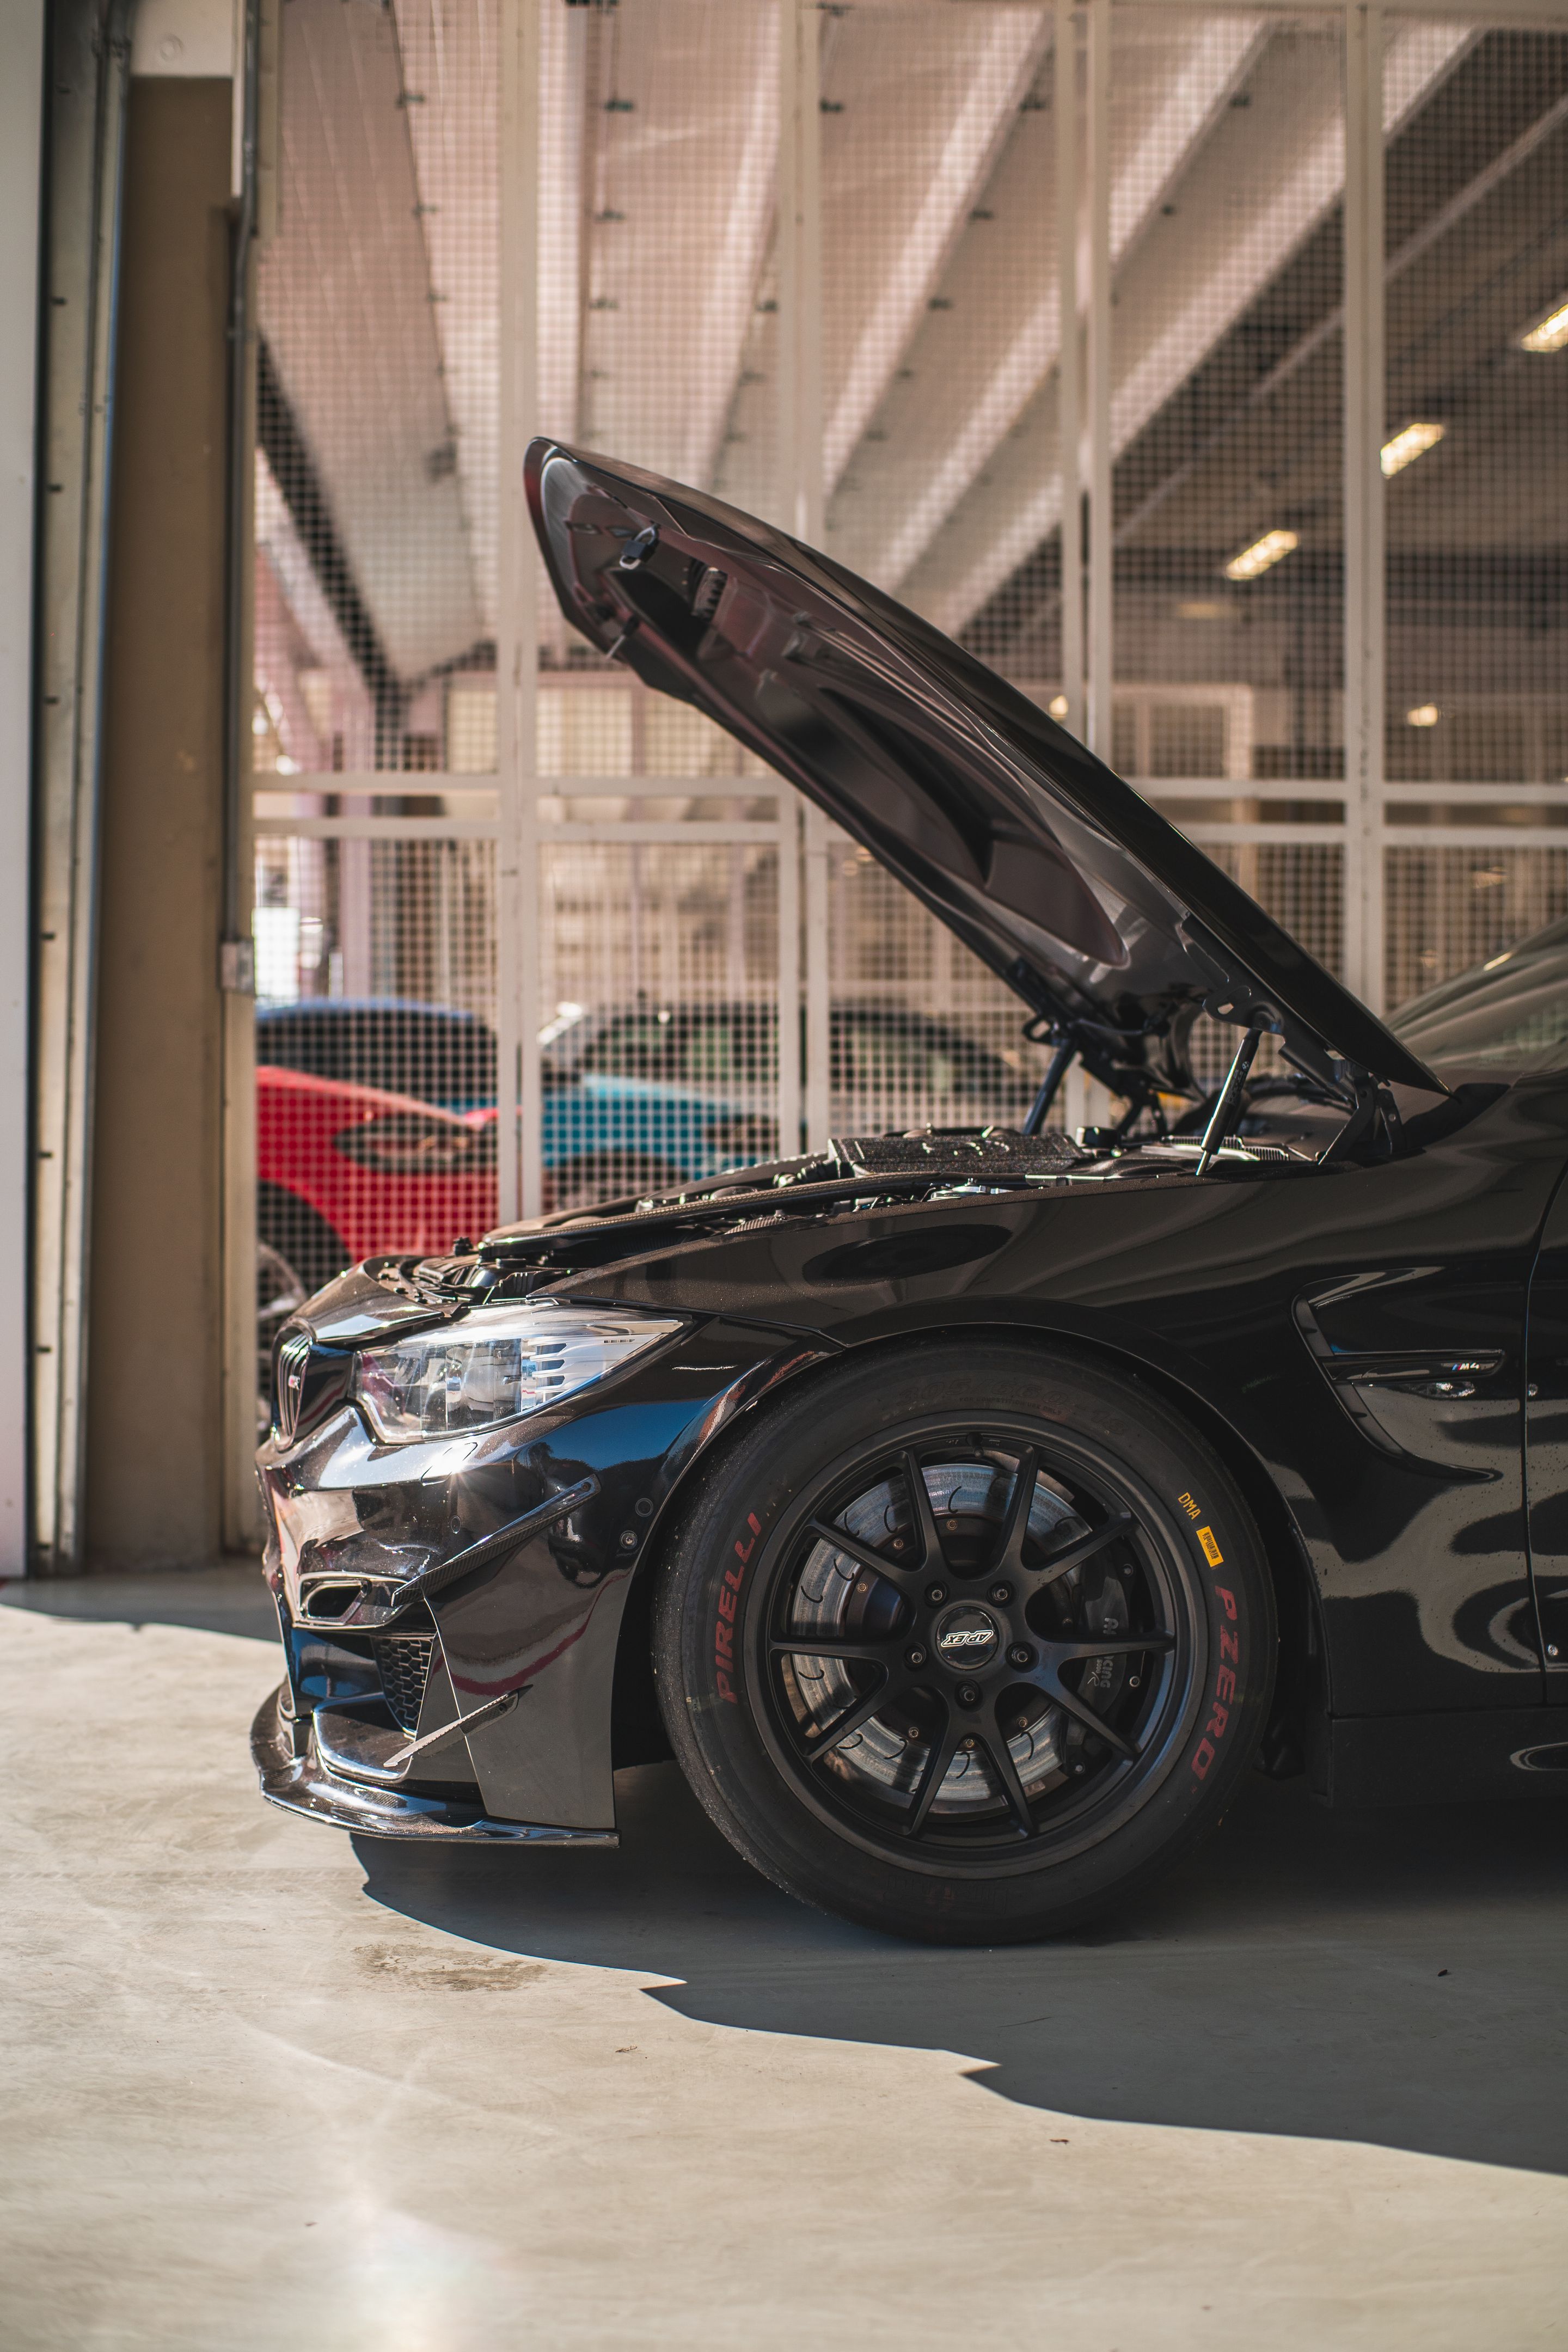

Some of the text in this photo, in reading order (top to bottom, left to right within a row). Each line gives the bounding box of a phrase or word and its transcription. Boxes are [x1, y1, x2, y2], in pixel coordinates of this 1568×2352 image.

[976, 1396, 1025, 1406] COMPETITION
[1042, 1405, 1062, 1415] ONLY
[1177, 1492, 1202, 1520] DMA
[715, 1512, 762, 1704] PIRELLI
[943, 1631, 991, 1645] APEX
